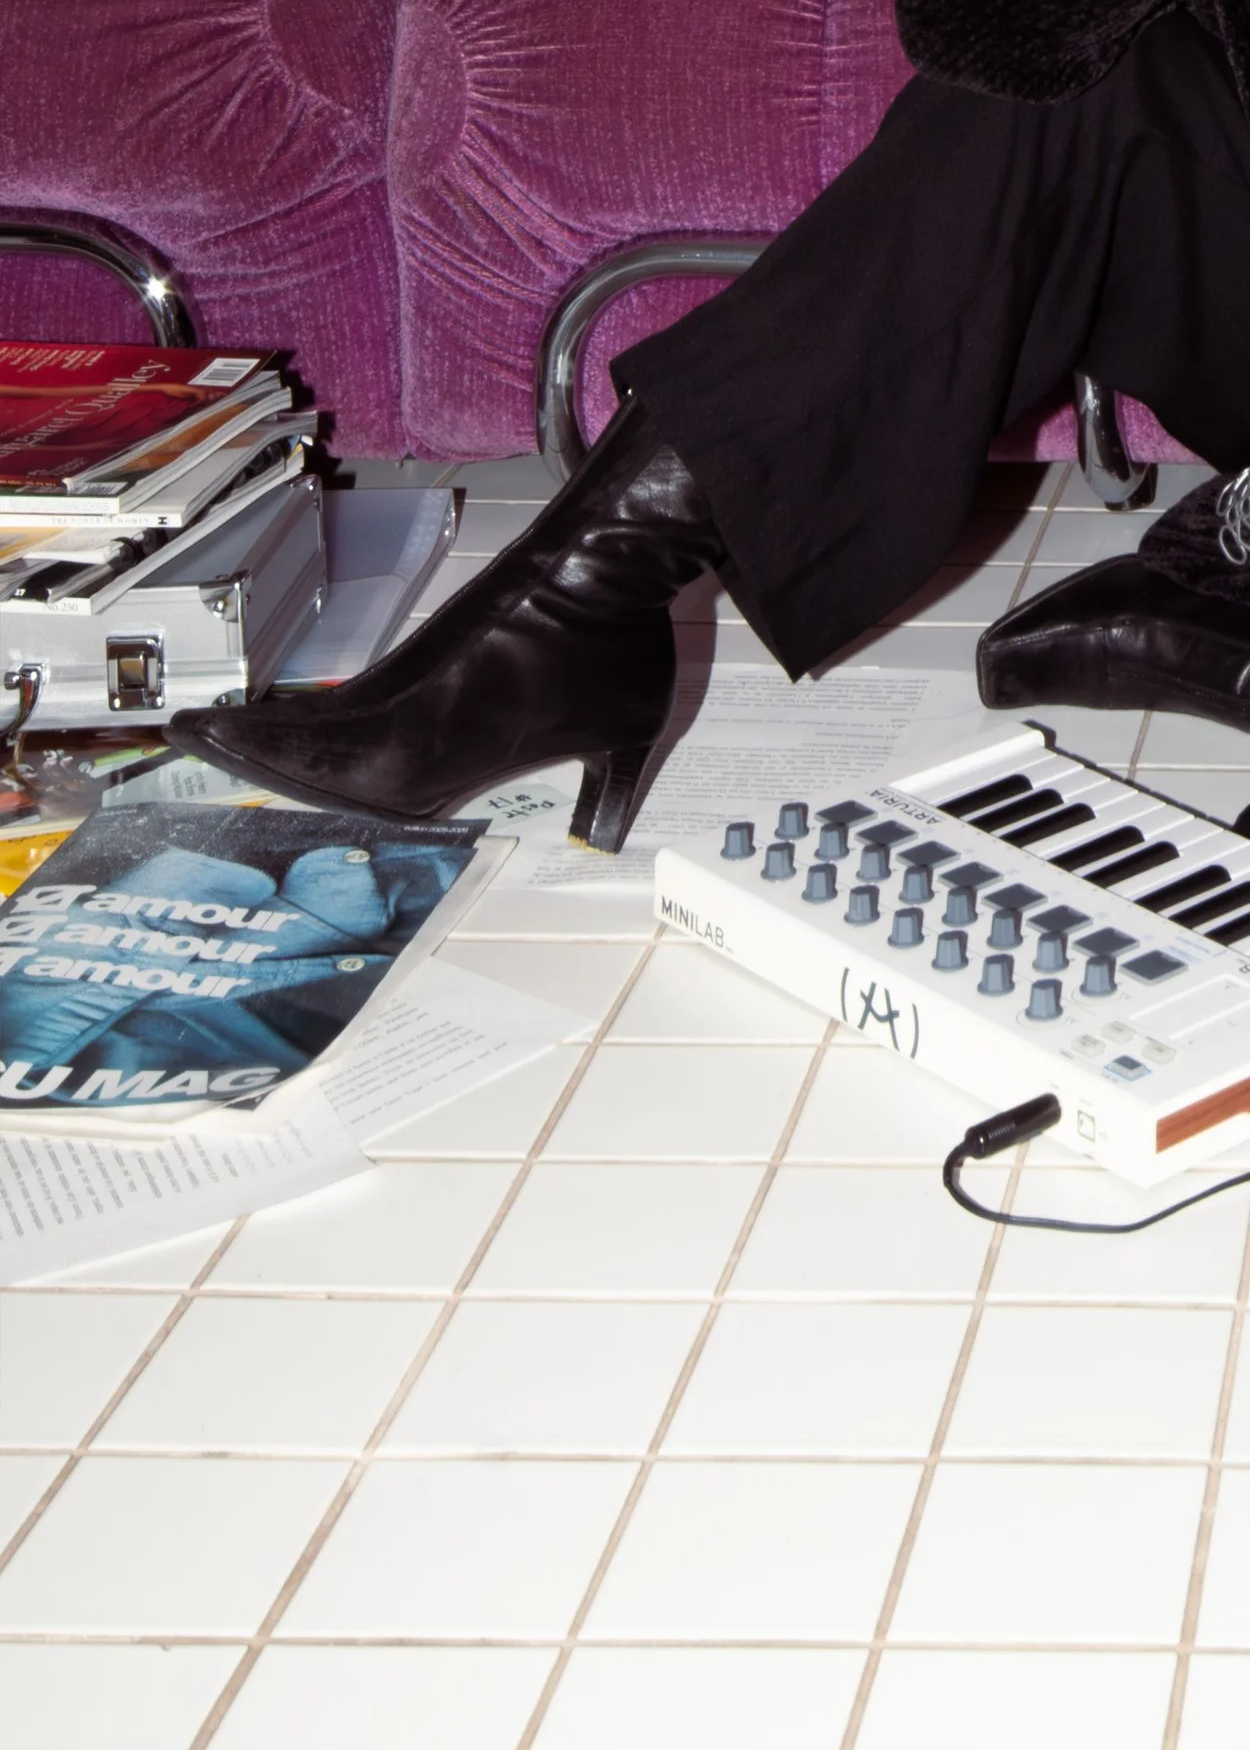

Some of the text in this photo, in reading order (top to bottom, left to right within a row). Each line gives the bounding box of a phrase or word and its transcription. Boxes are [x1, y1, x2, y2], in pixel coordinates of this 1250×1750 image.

[868, 789, 943, 825] ARTURIA
[82, 892, 301, 932] amour
[661, 895, 725, 948] MINILAB
[54, 922, 277, 964] amour
[24, 955, 252, 998] amour
[71, 1066, 280, 1100] MAG
